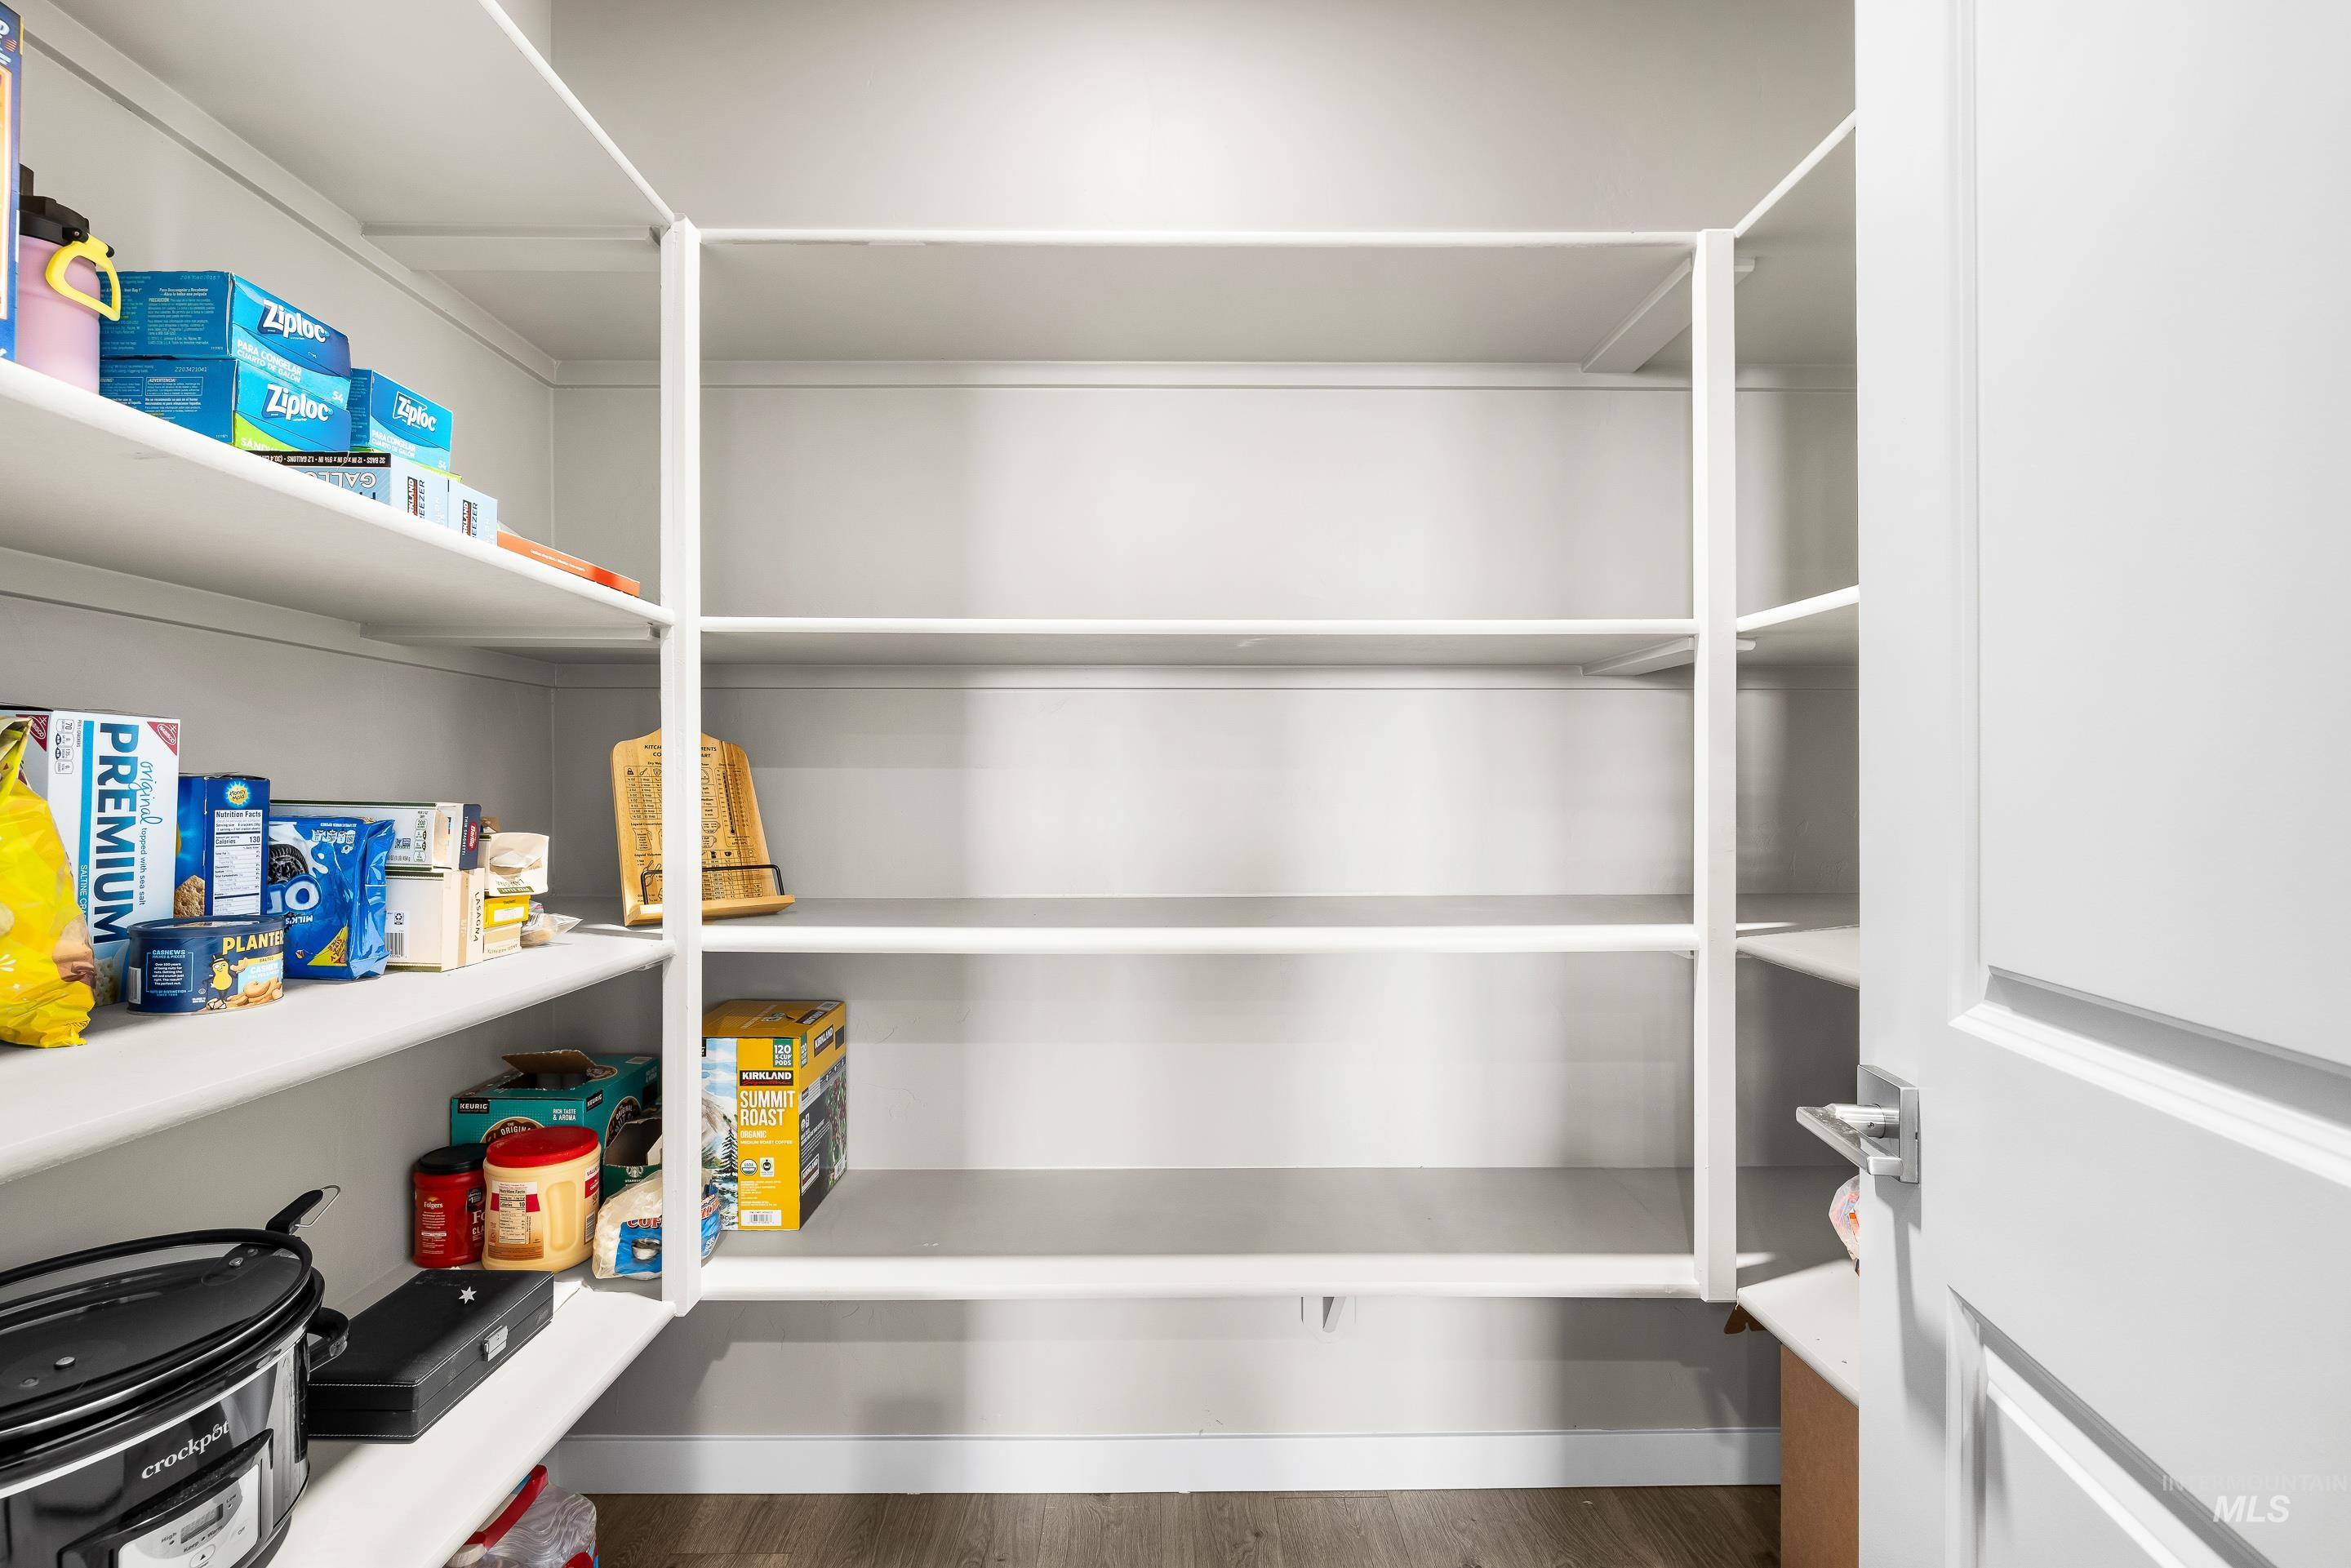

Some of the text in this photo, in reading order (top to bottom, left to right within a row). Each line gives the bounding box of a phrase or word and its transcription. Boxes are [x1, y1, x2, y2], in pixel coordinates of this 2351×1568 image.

[263, 299, 326, 343] Ziploc
[237, 339, 302, 375] PARA CONGELAR
[237, 349, 300, 384] CUARTO DE GALÓN
[266, 383, 329, 422] Ziploc
[331, 391, 344, 403] 54
[397, 395, 438, 432] Ziploc
[371, 429, 387, 441] PARA
[438, 460, 447, 470] 54
[32, 721, 44, 737] ABISCO
[158, 725, 176, 743] NABISCO
[128, 761, 163, 824] original
[93, 723, 139, 944] PREMIUM
[80, 864, 88, 896] SALTINE
[286, 914, 313, 924] MILK'S
[473, 891, 482, 942] LASAGNA
[815, 1028, 833, 1050] KIRKLAND
[774, 1045, 791, 1054] 120
[742, 1072, 792, 1080] KIRKLAND
[588, 1094, 602, 1107] KEURIG
[740, 1090, 796, 1108] SUMMIT
[740, 1108, 785, 1126] ROAST
[500, 1126, 531, 1135] ORIGIN
[424, 1202, 443, 1210] Folgers
[141, 1420, 229, 1479] crockpot
[226, 1494, 237, 1504] Low
[162, 1531, 177, 1544] High
[184, 1526, 223, 1553] Keep Warm
